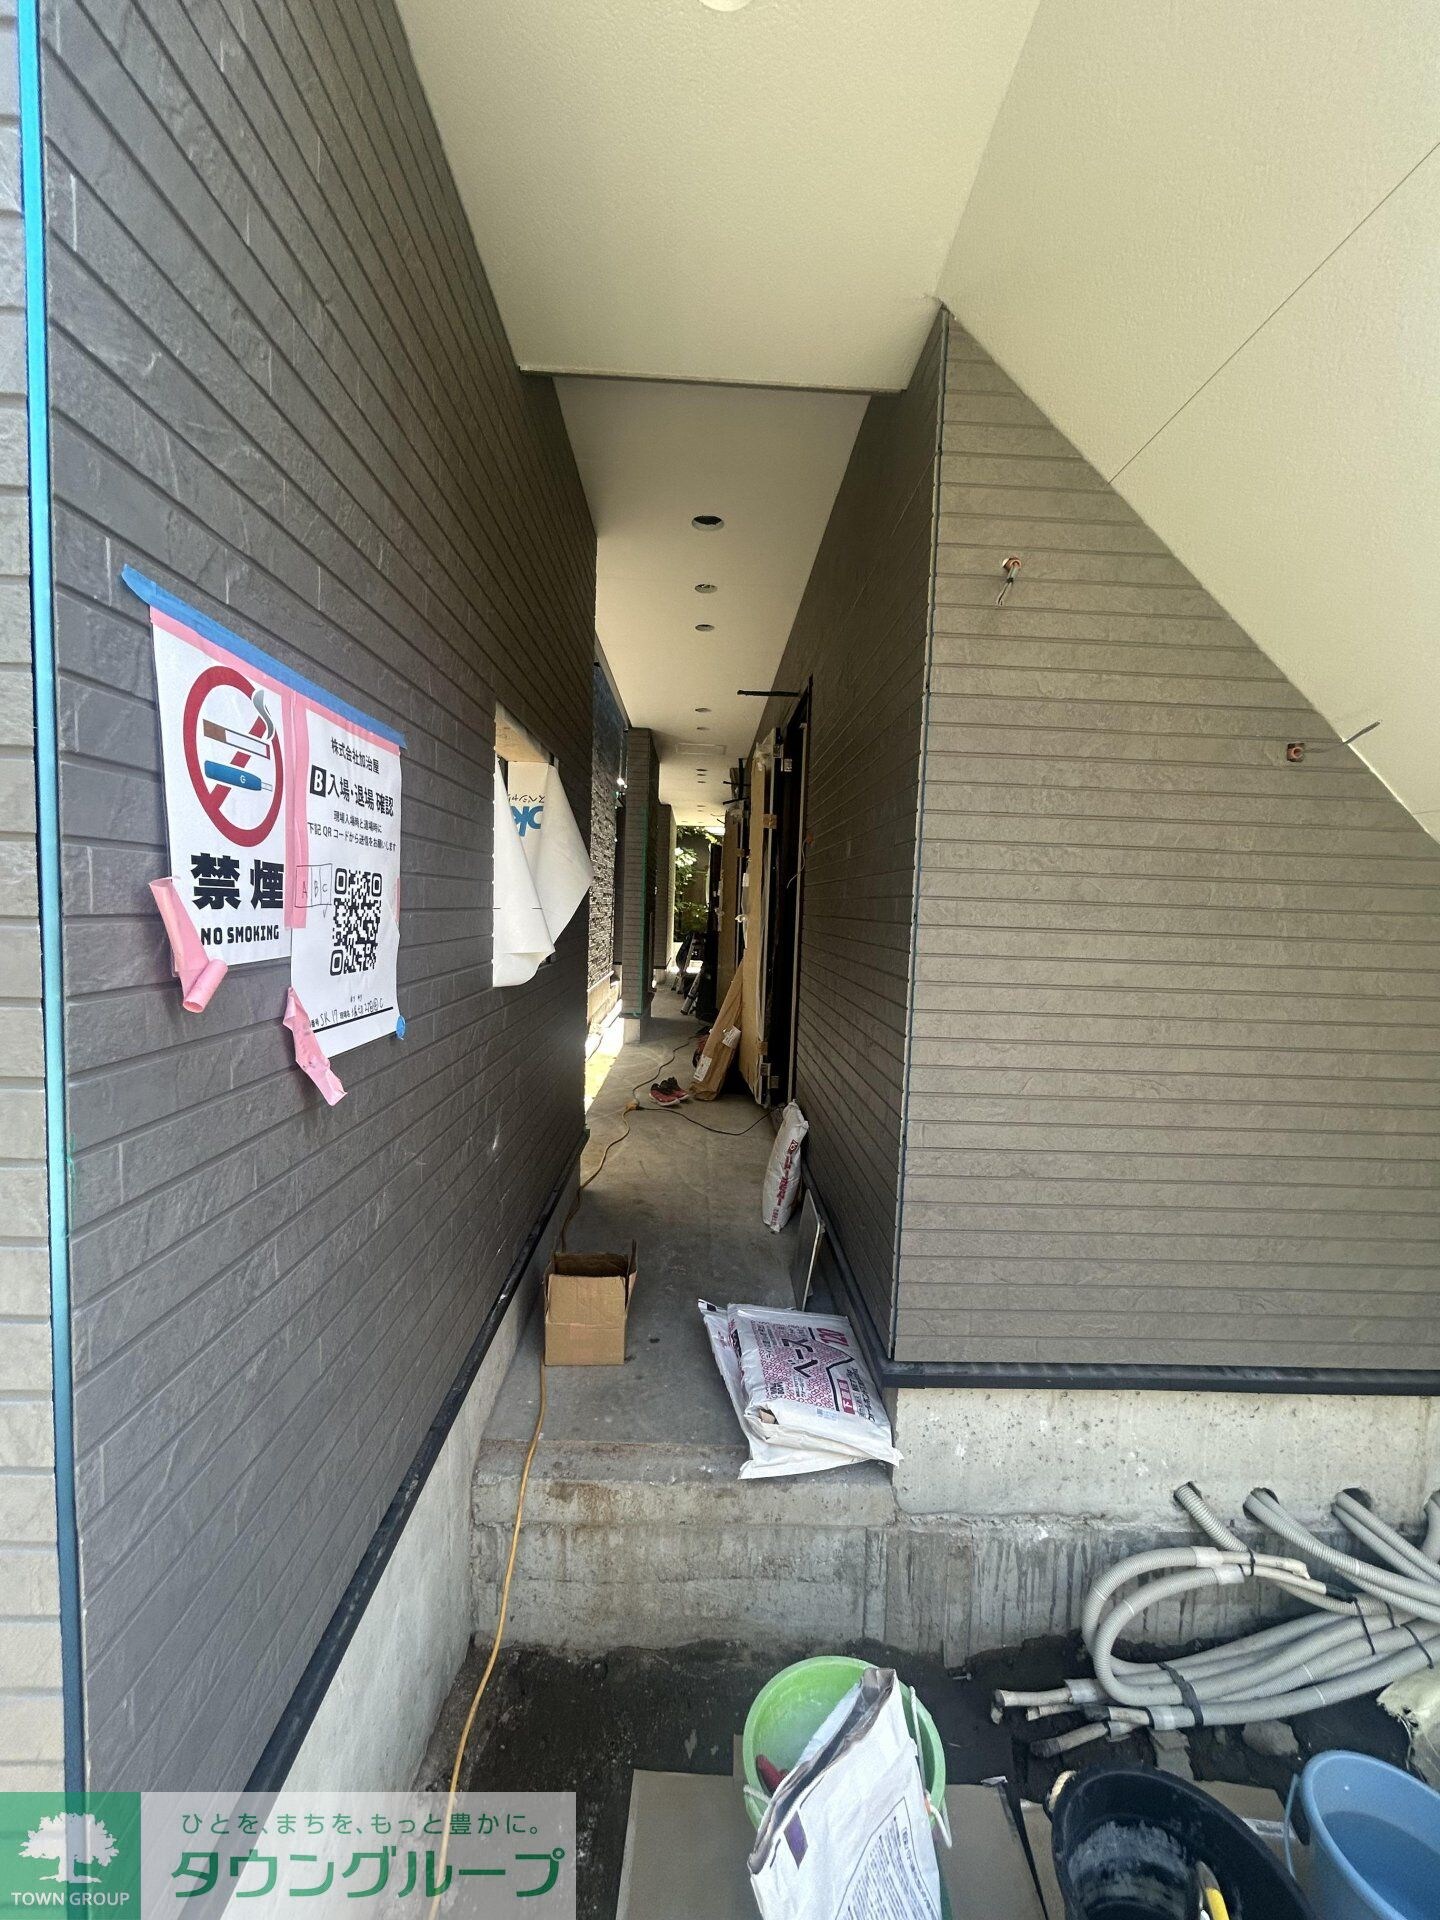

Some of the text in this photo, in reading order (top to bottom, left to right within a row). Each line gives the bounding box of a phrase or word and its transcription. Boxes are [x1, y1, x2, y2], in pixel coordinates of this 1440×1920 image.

[190, 852, 285, 910] 禁煙
[200, 924, 280, 946] NO SMOKING
